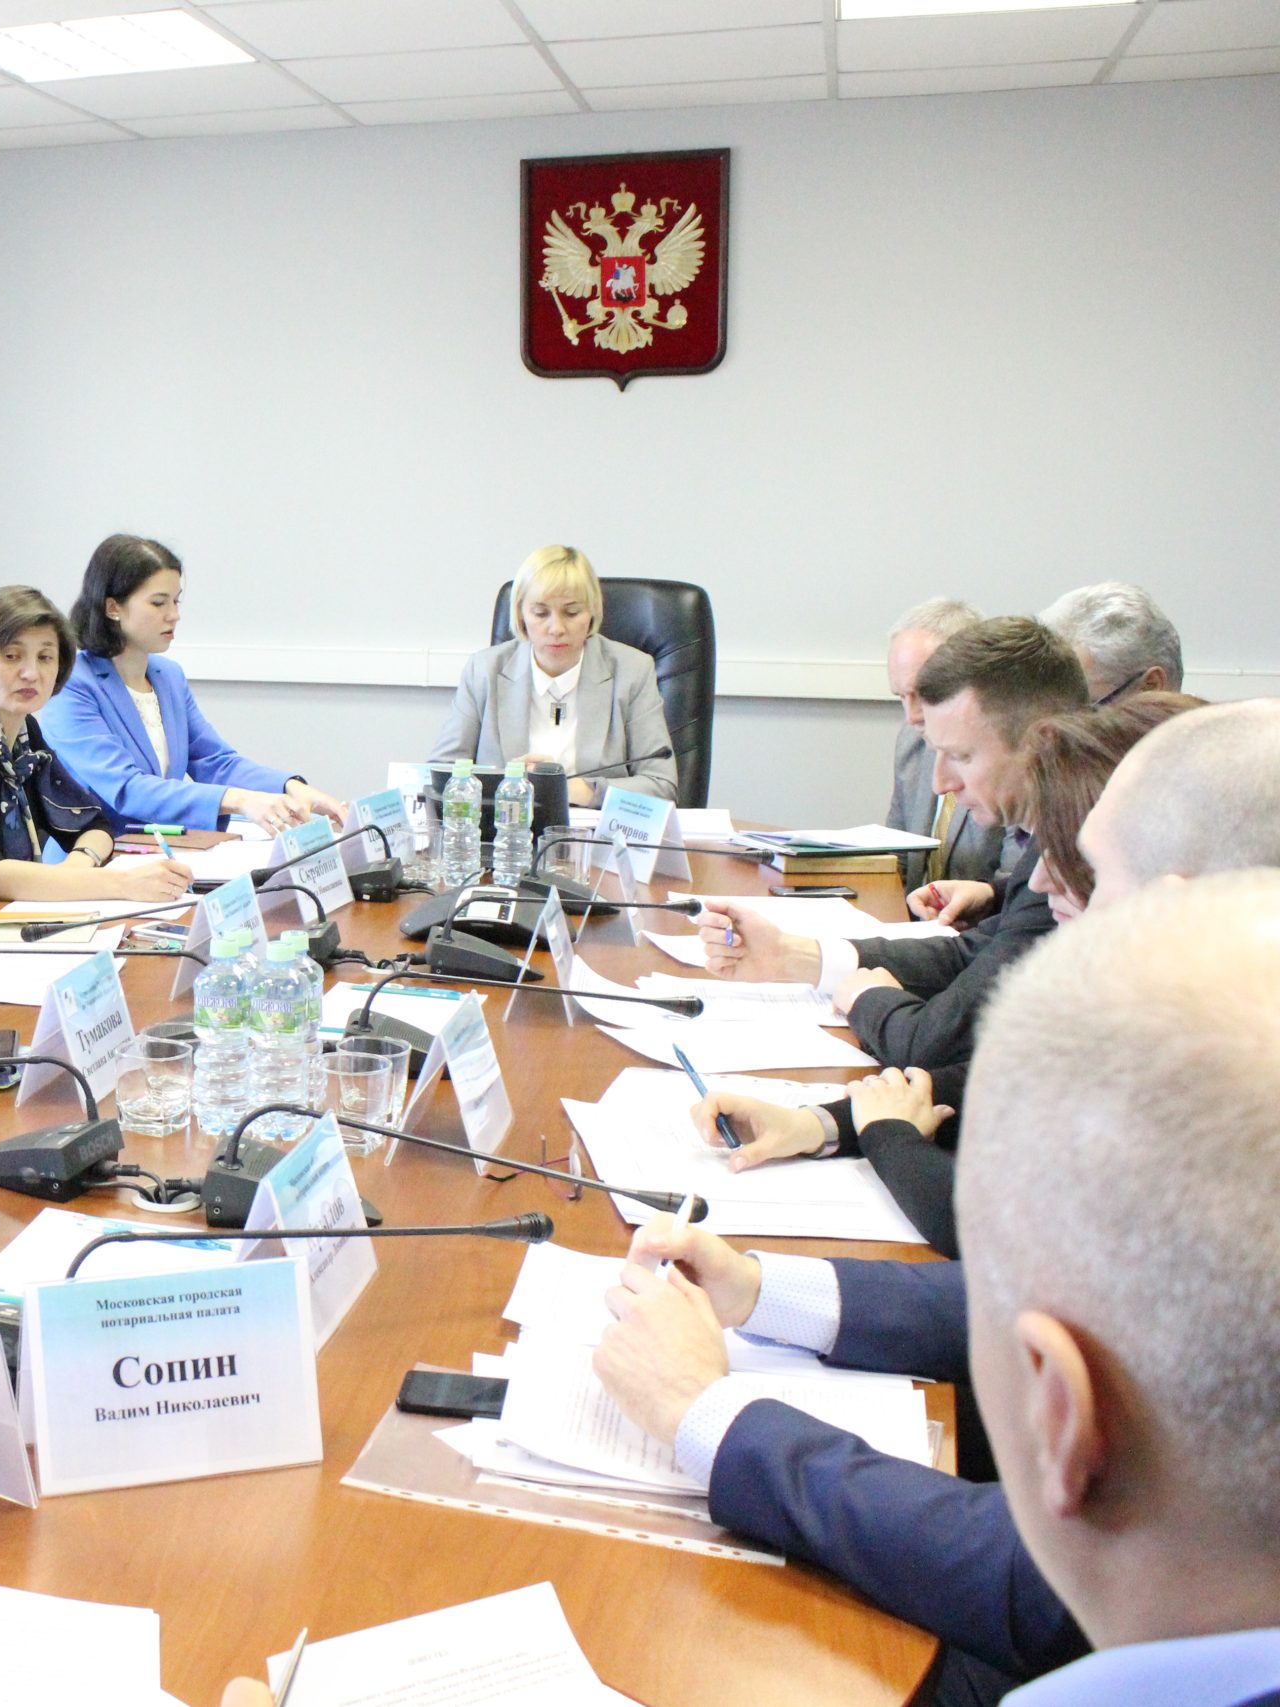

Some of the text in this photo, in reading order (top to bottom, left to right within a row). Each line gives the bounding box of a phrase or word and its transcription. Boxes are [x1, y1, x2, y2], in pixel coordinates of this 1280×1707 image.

[75, 1010, 122, 1055] Тумакова
[96, 1287, 242, 1311] Московская городская
[101, 1304, 240, 1329] нотариальная палата
[112, 1354, 238, 1389] Сопин
[95, 1392, 261, 1422] Вадим Николаевич
